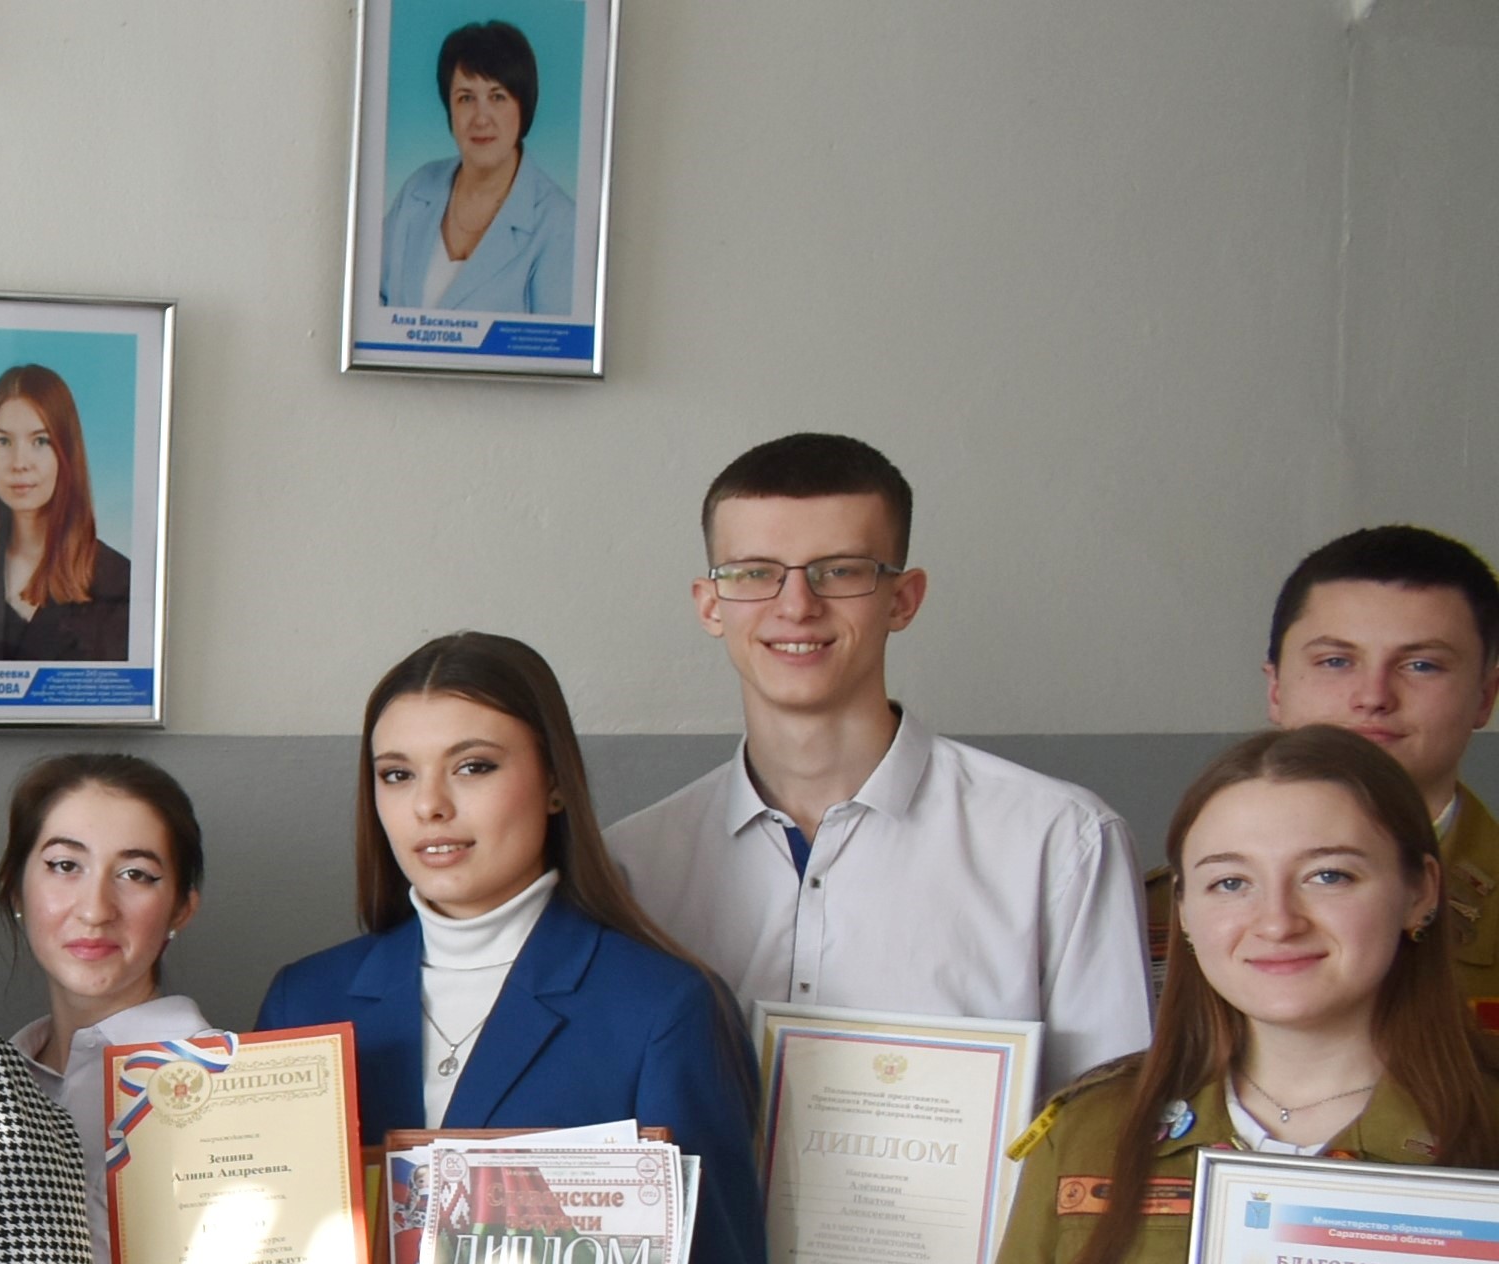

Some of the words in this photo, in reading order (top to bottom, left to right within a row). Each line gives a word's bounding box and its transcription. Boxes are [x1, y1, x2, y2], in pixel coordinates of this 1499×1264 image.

[391, 313, 417, 326] Алла
[419, 315, 478, 328] Васильевна
[406, 329, 463, 343] ФЕДОТОВА
[213, 1070, 312, 1094] ДИПЛОМ
[804, 1129, 958, 1166] ДИПЛОМ
[208, 1152, 254, 1164] Зенина
[172, 1168, 213, 1183] Алина
[853, 1194, 895, 1207] Платон
[840, 1206, 906, 1222] Алексеевич
[1312, 1215, 1390, 1231] Министерство
[1392, 1223, 1464, 1238] образования
[1328, 1228, 1398, 1243] Саратовской
[1400, 1234, 1446, 1247] области
